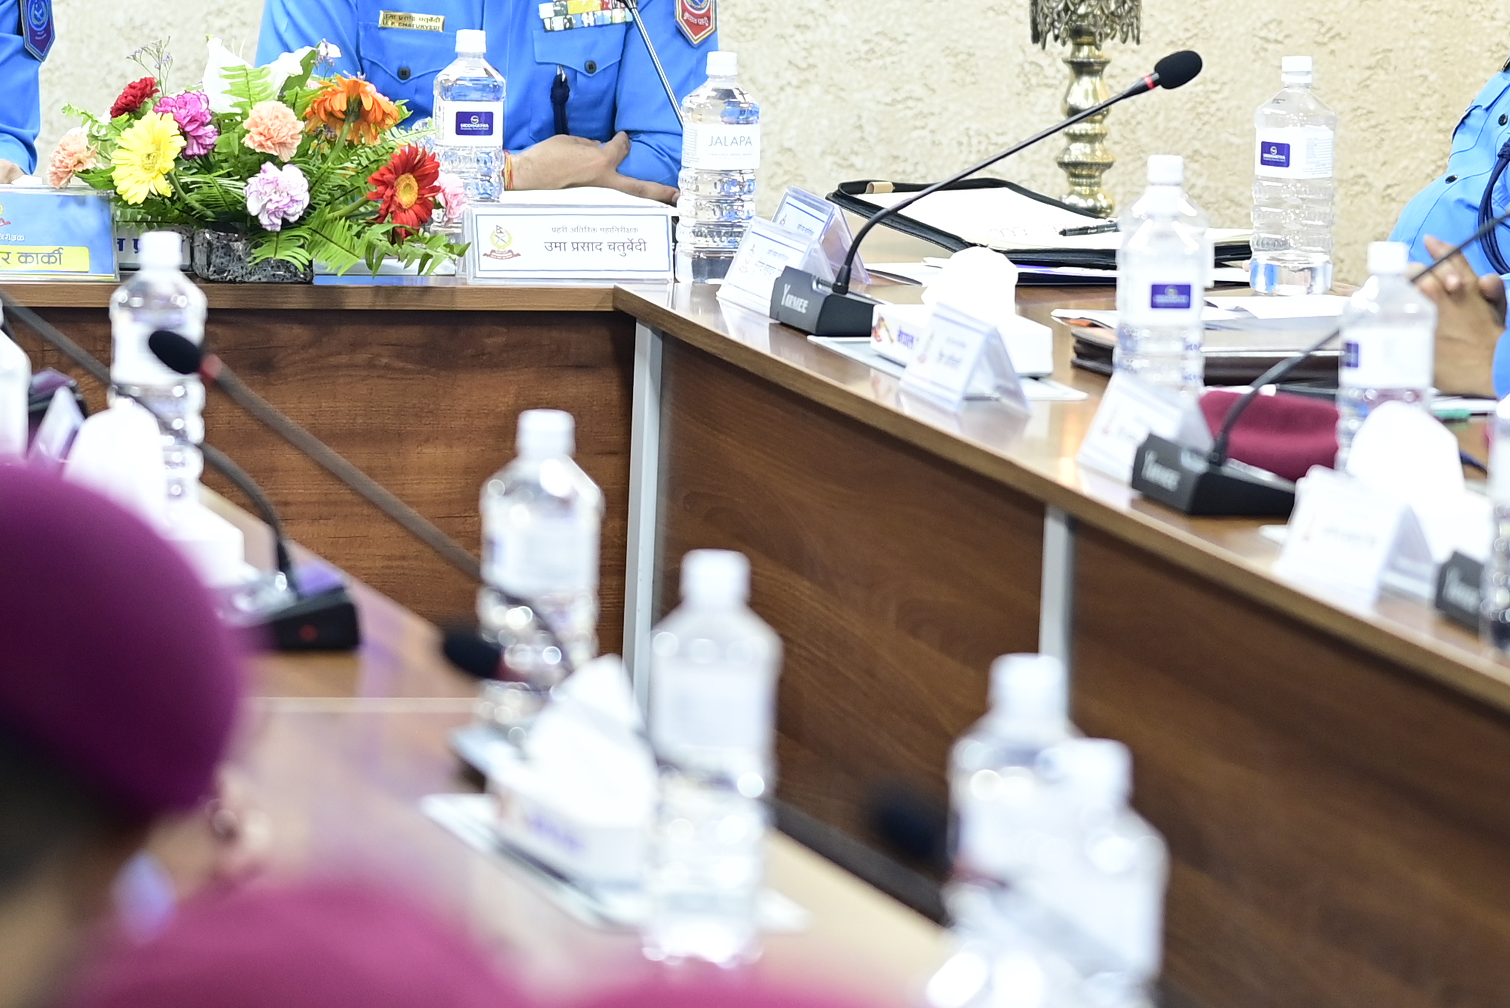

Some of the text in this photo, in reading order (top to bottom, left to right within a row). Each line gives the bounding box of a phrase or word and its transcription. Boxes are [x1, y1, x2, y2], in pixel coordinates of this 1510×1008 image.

[708, 135, 752, 147] JALAPA
[17, 247, 64, 265] कार्की
[544, 238, 647, 257] उमा प्रसाद चतुर्वेदी
